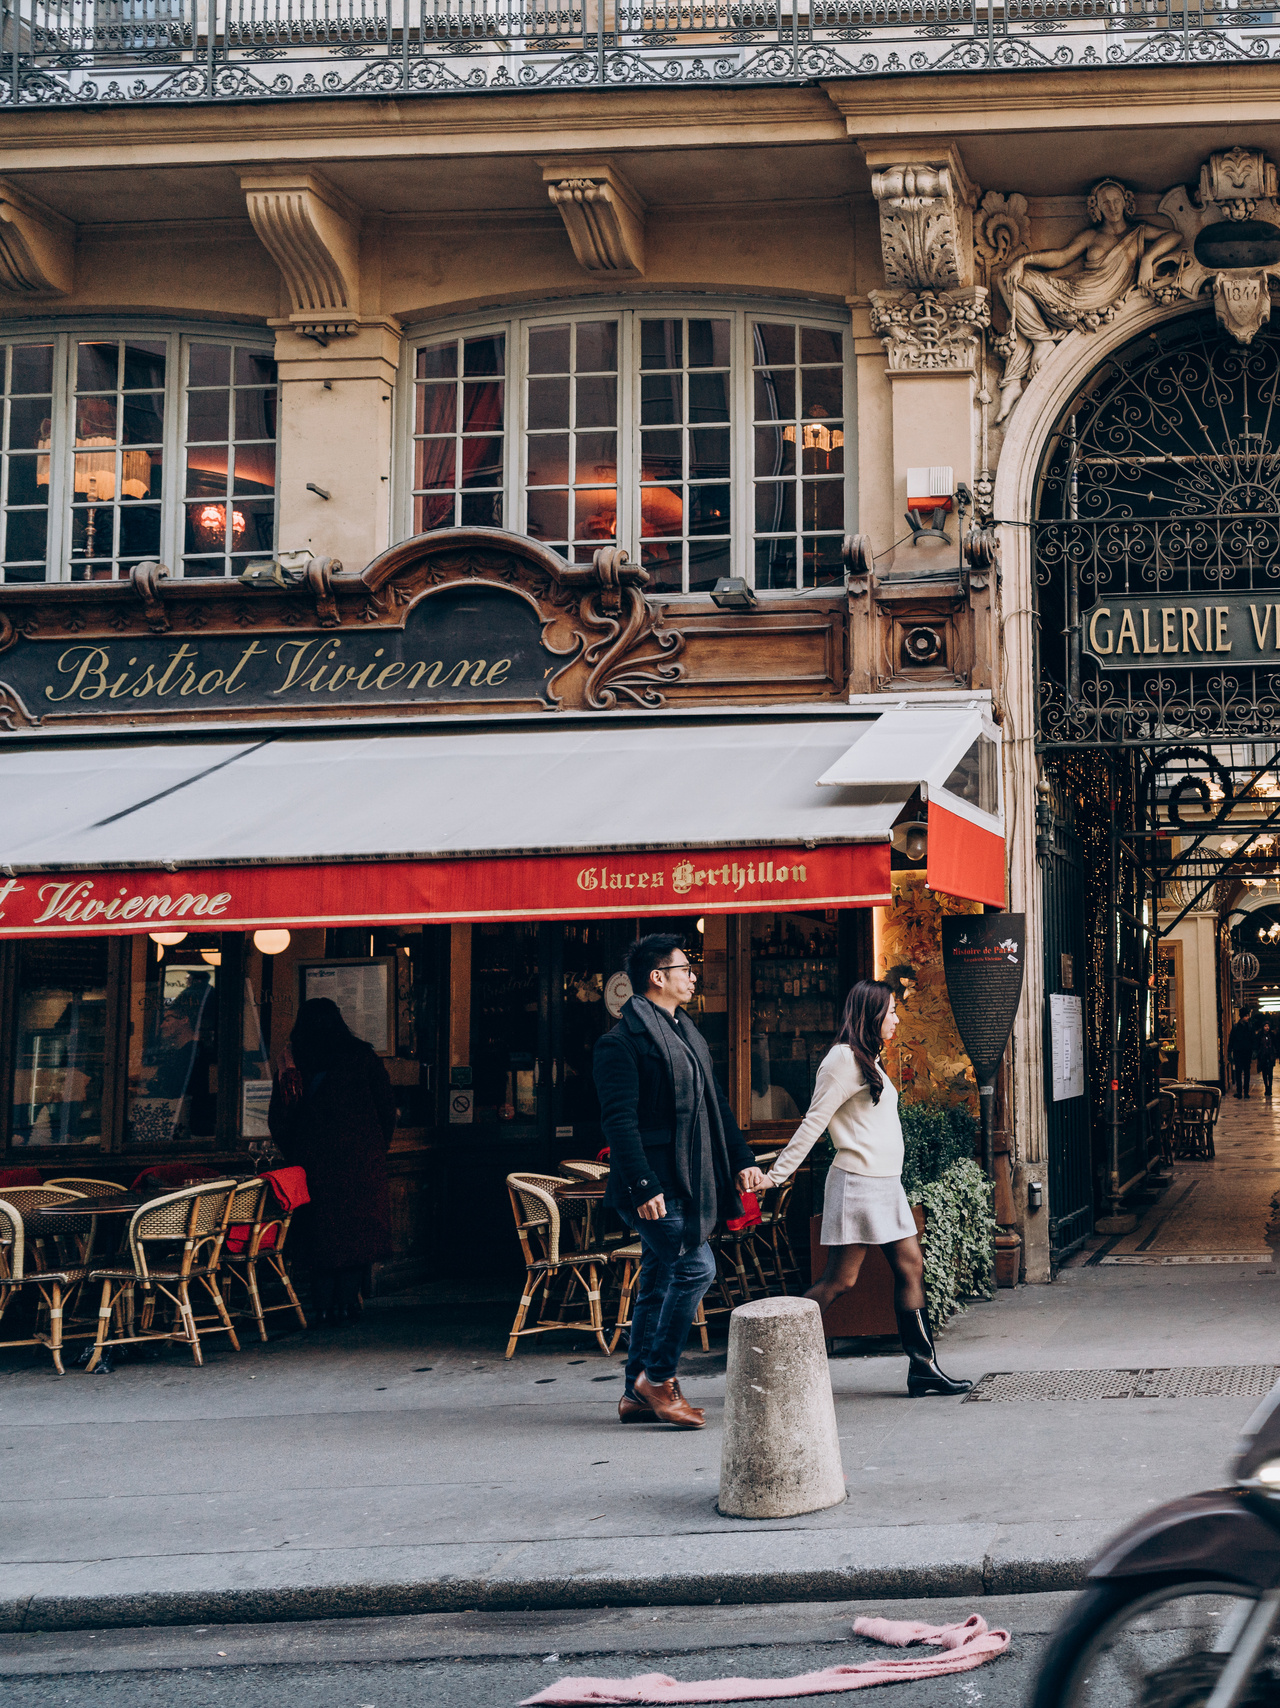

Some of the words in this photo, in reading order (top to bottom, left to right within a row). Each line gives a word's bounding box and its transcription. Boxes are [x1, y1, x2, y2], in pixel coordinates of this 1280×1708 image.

[1227, 286, 1258, 301] 1844
[1089, 605, 1233, 655] GALERIE
[45, 640, 269, 702] Bistrot
[273, 637, 513, 694] Vivienne
[576, 867, 664, 892] Glaces
[671, 859, 808, 895] Berthillon
[33, 880, 232, 924] Vivienne
